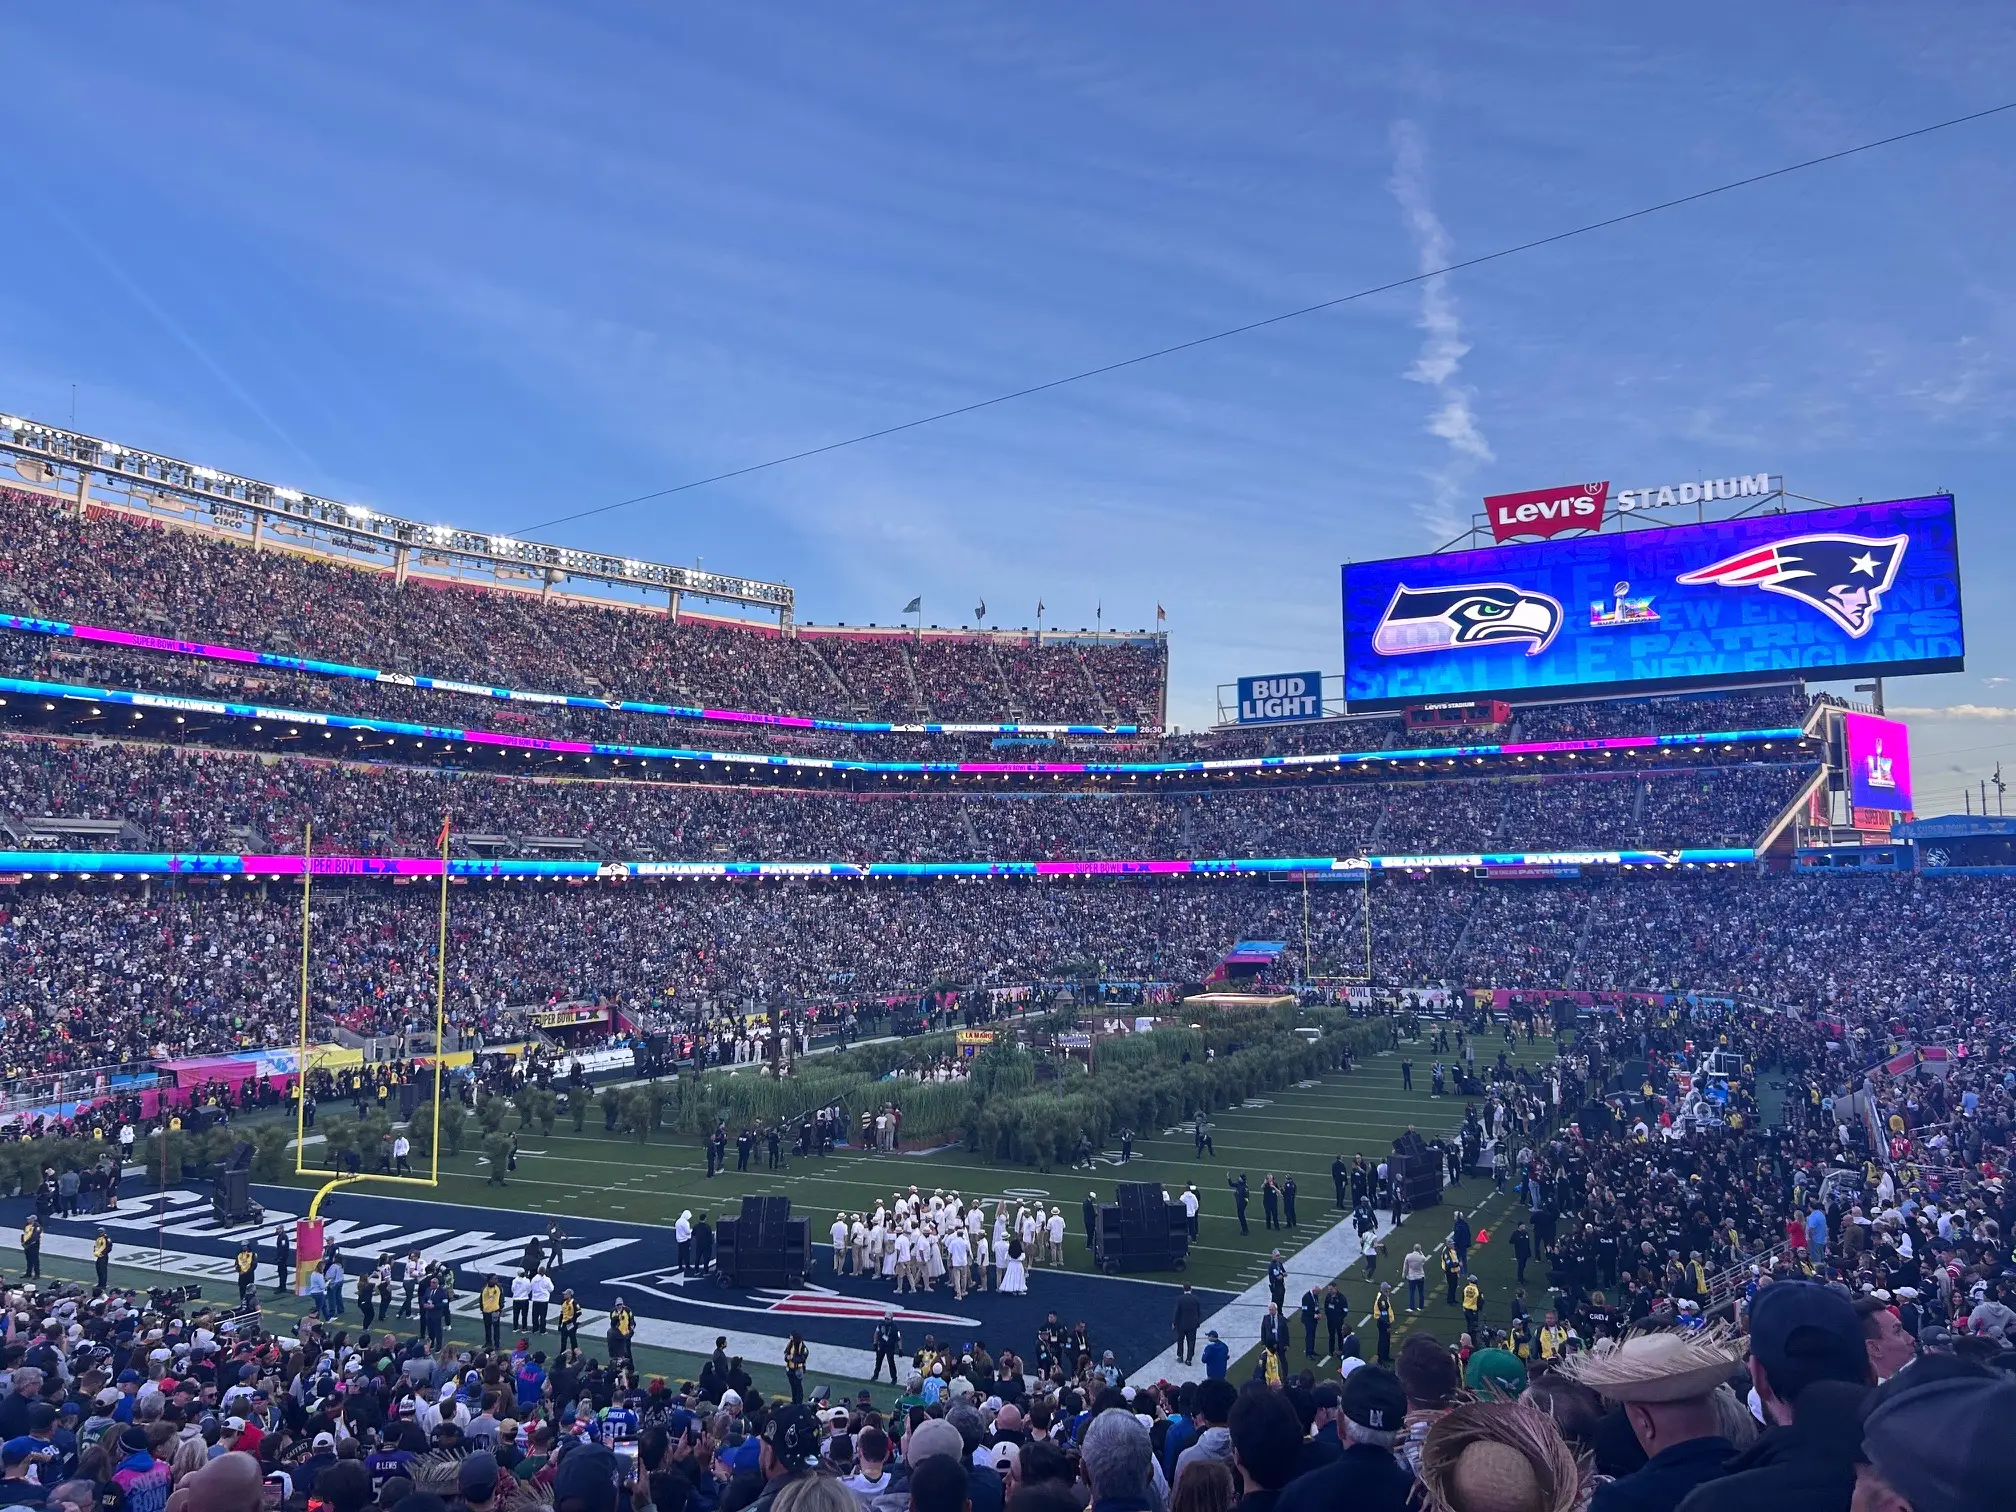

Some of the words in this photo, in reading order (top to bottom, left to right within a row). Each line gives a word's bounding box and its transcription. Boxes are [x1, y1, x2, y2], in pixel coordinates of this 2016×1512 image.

[1616, 472, 1770, 513] STADIUM
[213, 516, 243, 529] CISCO
[331, 536, 378, 555] ticketmaster
[132, 635, 156, 647] SUPER
[157, 638, 178, 650] BOWL
[1348, 634, 1616, 698] SEATTLE
[1632, 652, 1726, 681] NEW
[1745, 636, 1963, 672] ENGLAND
[1252, 678, 1306, 699] BUD
[132, 696, 226, 714] SEAHAWKS
[256, 709, 328, 725] PATRIOTS
[1242, 696, 1317, 719] LIGHT
[1140, 726, 1163, 734] 26:30
[300, 858, 332, 873] SUPER
[335, 858, 359, 873] BOWL
[362, 859, 400, 873] LX
[1075, 862, 1099, 873] SUPER
[1100, 862, 1122, 873] BOWL
[1122, 862, 1151, 873] LX
[1380, 855, 1483, 867] SEAHAWKS
[1523, 853, 1621, 865] PATRIOTS
[636, 863, 726, 874] SEAHAWKS
[760, 863, 832, 874] PATRIOTS
[556, 1012, 574, 1024] BOWL
